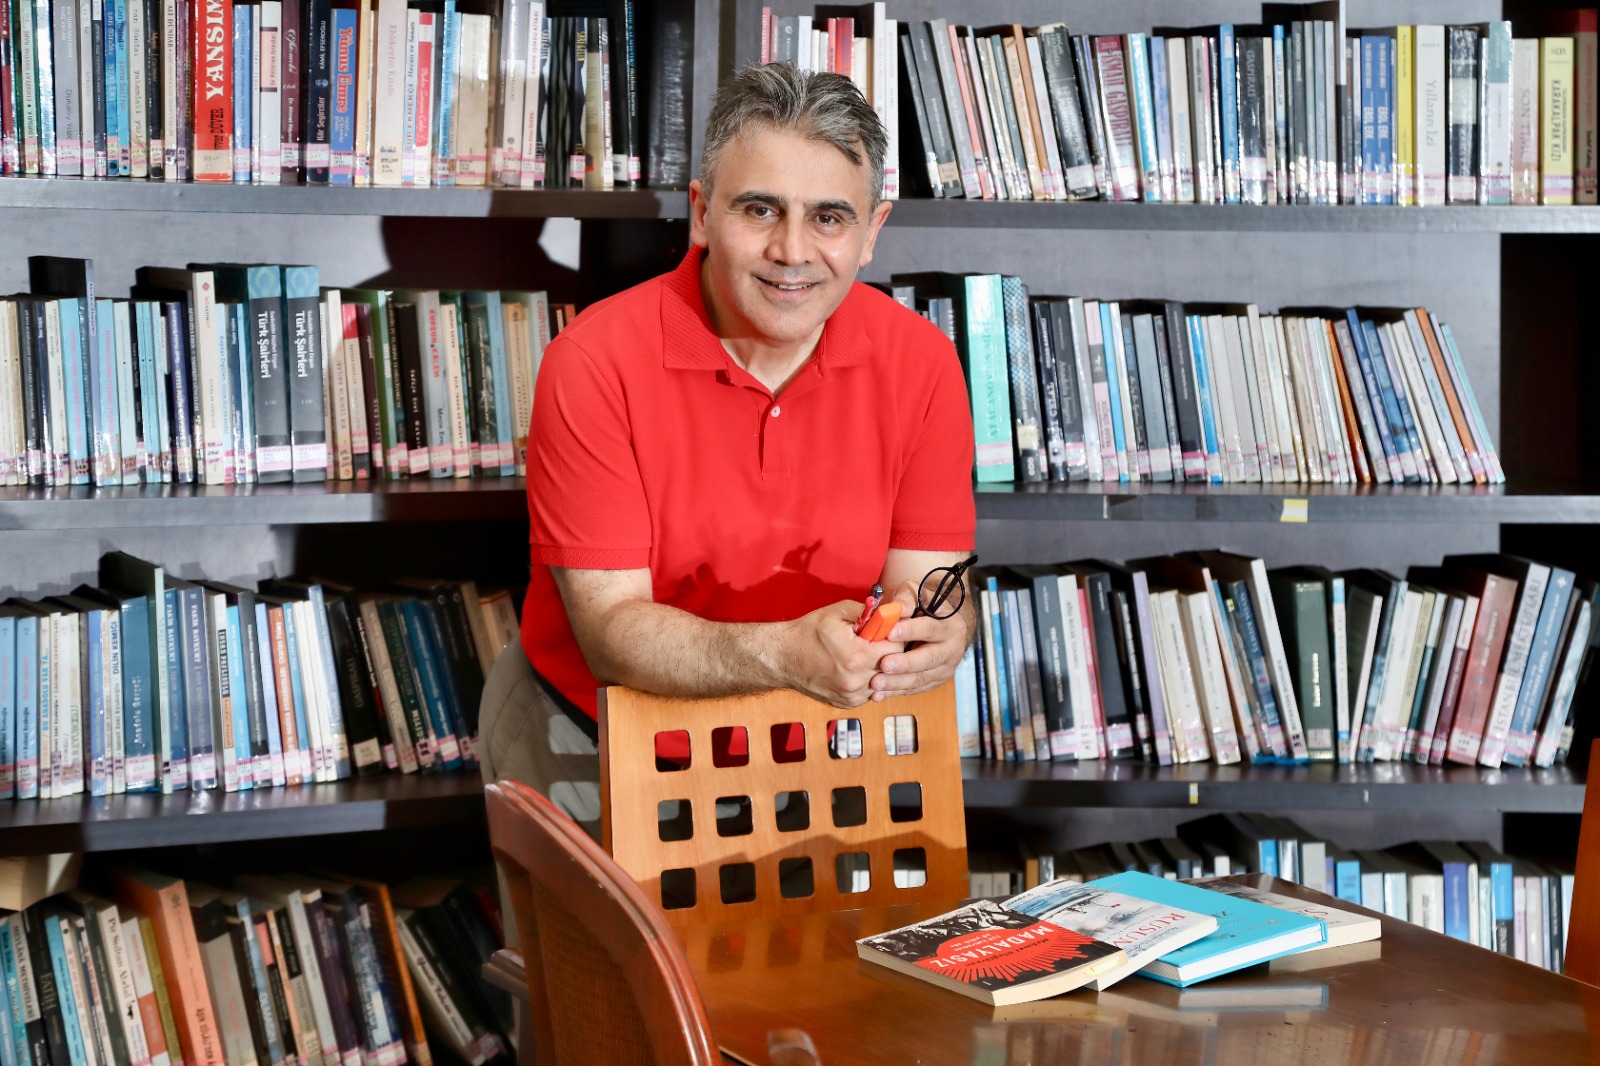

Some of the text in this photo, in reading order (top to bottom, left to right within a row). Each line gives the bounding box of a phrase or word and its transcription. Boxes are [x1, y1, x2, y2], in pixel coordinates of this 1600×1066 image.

[337, 73, 352, 113] Emre
[386, 69, 397, 96] Kitabı
[209, 107, 224, 134] DÜVER
[1551, 79, 1561, 162] KARAKALPAK KIZI
[257, 311, 271, 379] Türk Şairleri
[294, 311, 308, 377] Türk Şairleri
[191, 604, 200, 627] FAKİR
[166, 604, 175, 662] FAKİR BAYKURT
[191, 628, 201, 663] BAYKURT
[41, 667, 49, 682] VAR
[111, 651, 120, 675] DİLİN
[41, 684, 49, 718] ANADOLU
[41, 720, 49, 731] BU
[928, 924, 1054, 969] MADALYASIZ
[1018, 938, 1050, 954] Mehmet
[111, 933, 123, 968] Sultan
[118, 968, 132, 1003] Abdal
